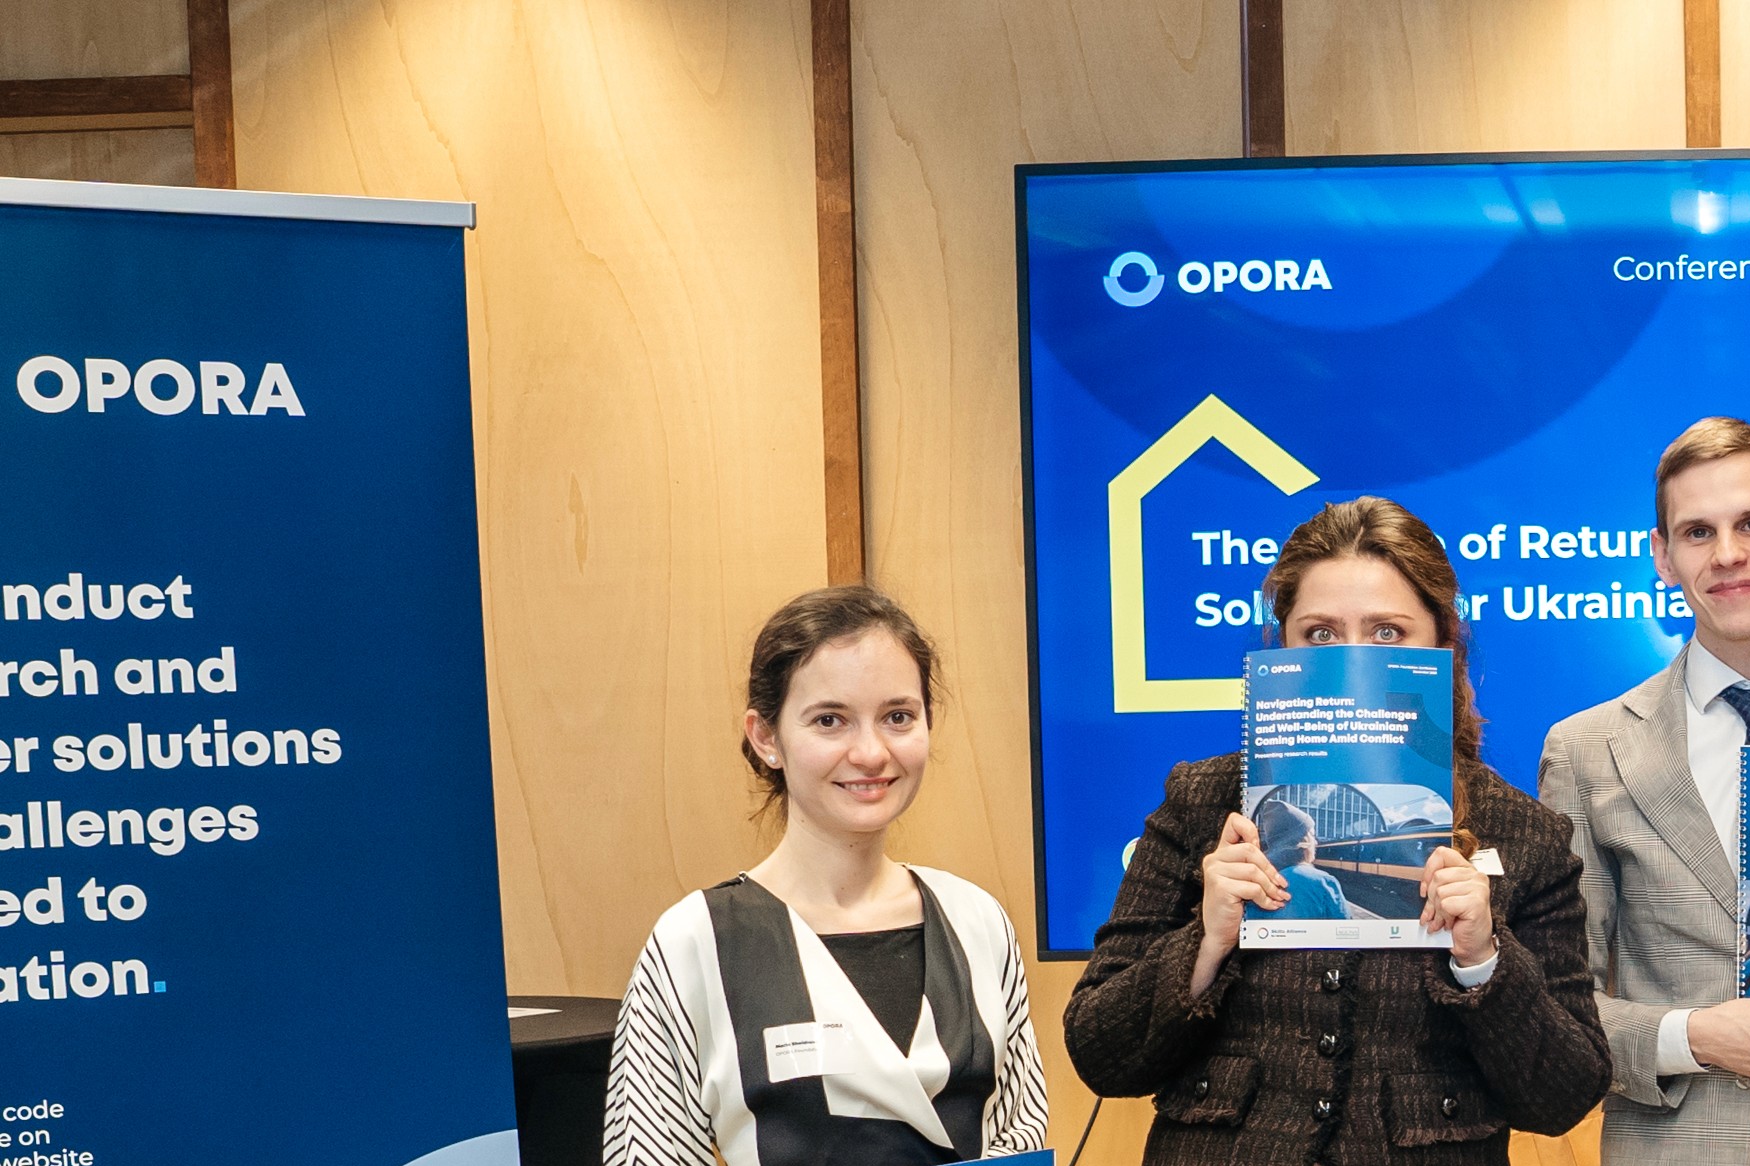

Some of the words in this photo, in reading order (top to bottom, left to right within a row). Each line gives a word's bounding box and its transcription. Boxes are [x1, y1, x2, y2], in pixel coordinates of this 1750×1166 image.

[1178, 259, 1332, 293] OPORA
[17, 355, 306, 416] OPORA
[1192, 530, 1278, 565] The
[1459, 524, 1507, 560] of
[1520, 525, 1655, 559] Retur
[3, 573, 193, 620] nduct
[1503, 581, 1694, 621] Ukrainia
[114, 647, 237, 695] and
[1271, 665, 1302, 674] OPORA
[1256, 698, 1313, 709] Navigating
[1316, 697, 1354, 706] Return:
[1256, 710, 1333, 721] Understanding
[1356, 710, 1417, 720] Challenges
[53, 720, 342, 772] solutions
[1255, 724, 1275, 733] and
[1277, 723, 1334, 733] Well-Being
[1350, 722, 1408, 732] Ukrainians
[1255, 735, 1294, 746] Coming
[1297, 735, 1328, 743] Home
[1329, 734, 1358, 743] Amid
[1359, 734, 1404, 744] Conflict
[0, 800, 259, 856] allenges
[77, 877, 147, 921] to
[0, 951, 166, 1003] ation.
[3, 1099, 64, 1122] code
[18, 1130, 50, 1146] on
